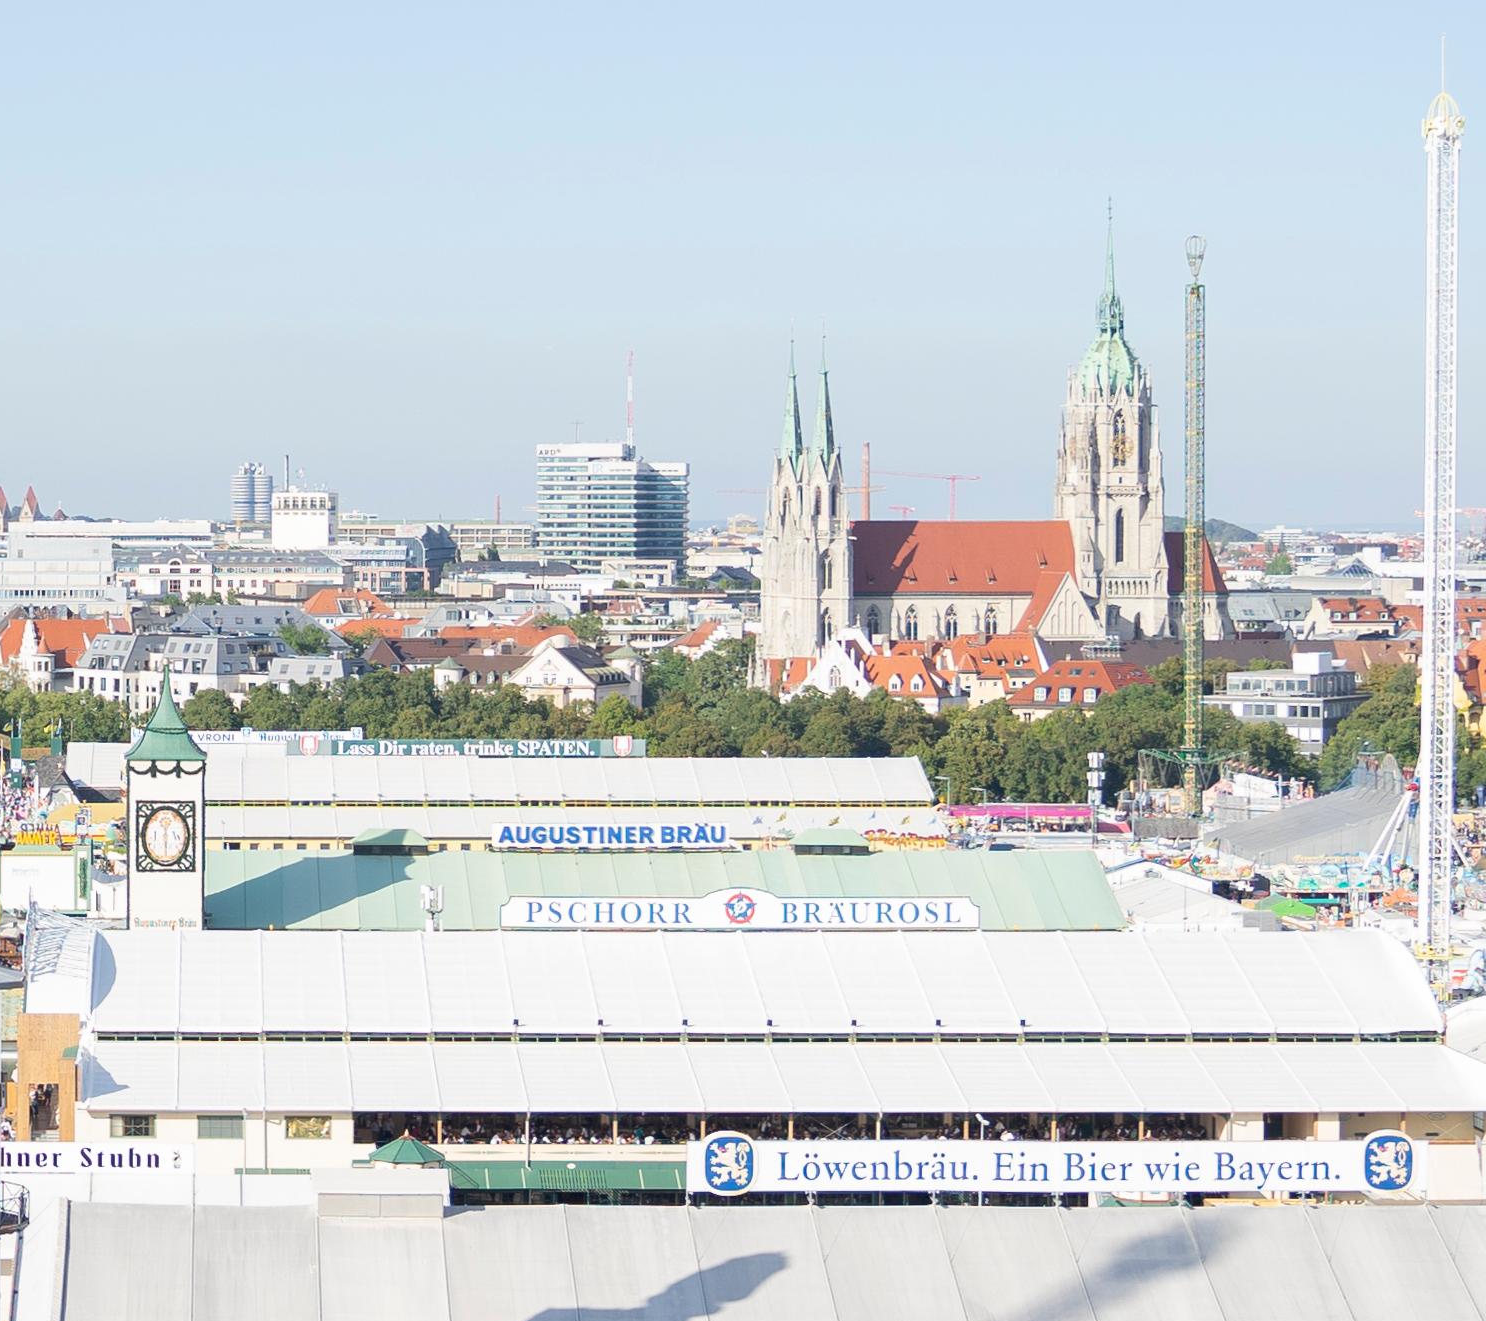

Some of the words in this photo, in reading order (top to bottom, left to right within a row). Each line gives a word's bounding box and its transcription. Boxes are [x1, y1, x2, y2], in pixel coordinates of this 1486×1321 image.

[198, 733, 235, 742] VRONI
[337, 741, 376, 756] Lass
[379, 741, 404, 756] Dir
[408, 743, 459, 758] raten,
[464, 741, 514, 756] trinke
[518, 741, 595, 756] SPATEN.
[15, 830, 56, 845] AMMER
[499, 825, 654, 844] AUGUSTINER
[661, 823, 727, 844] BRÄU
[526, 902, 693, 924] PSCHORR
[781, 901, 962, 924] BRÄUROSL
[81, 1147, 160, 1168] Stubn
[777, 1151, 979, 1182] Löwenbräu.
[994, 1151, 1050, 1182] Ein
[1063, 1152, 1133, 1182] Bier
[1145, 1152, 1200, 1182] wie
[1215, 1152, 1341, 1190] Bayern.
